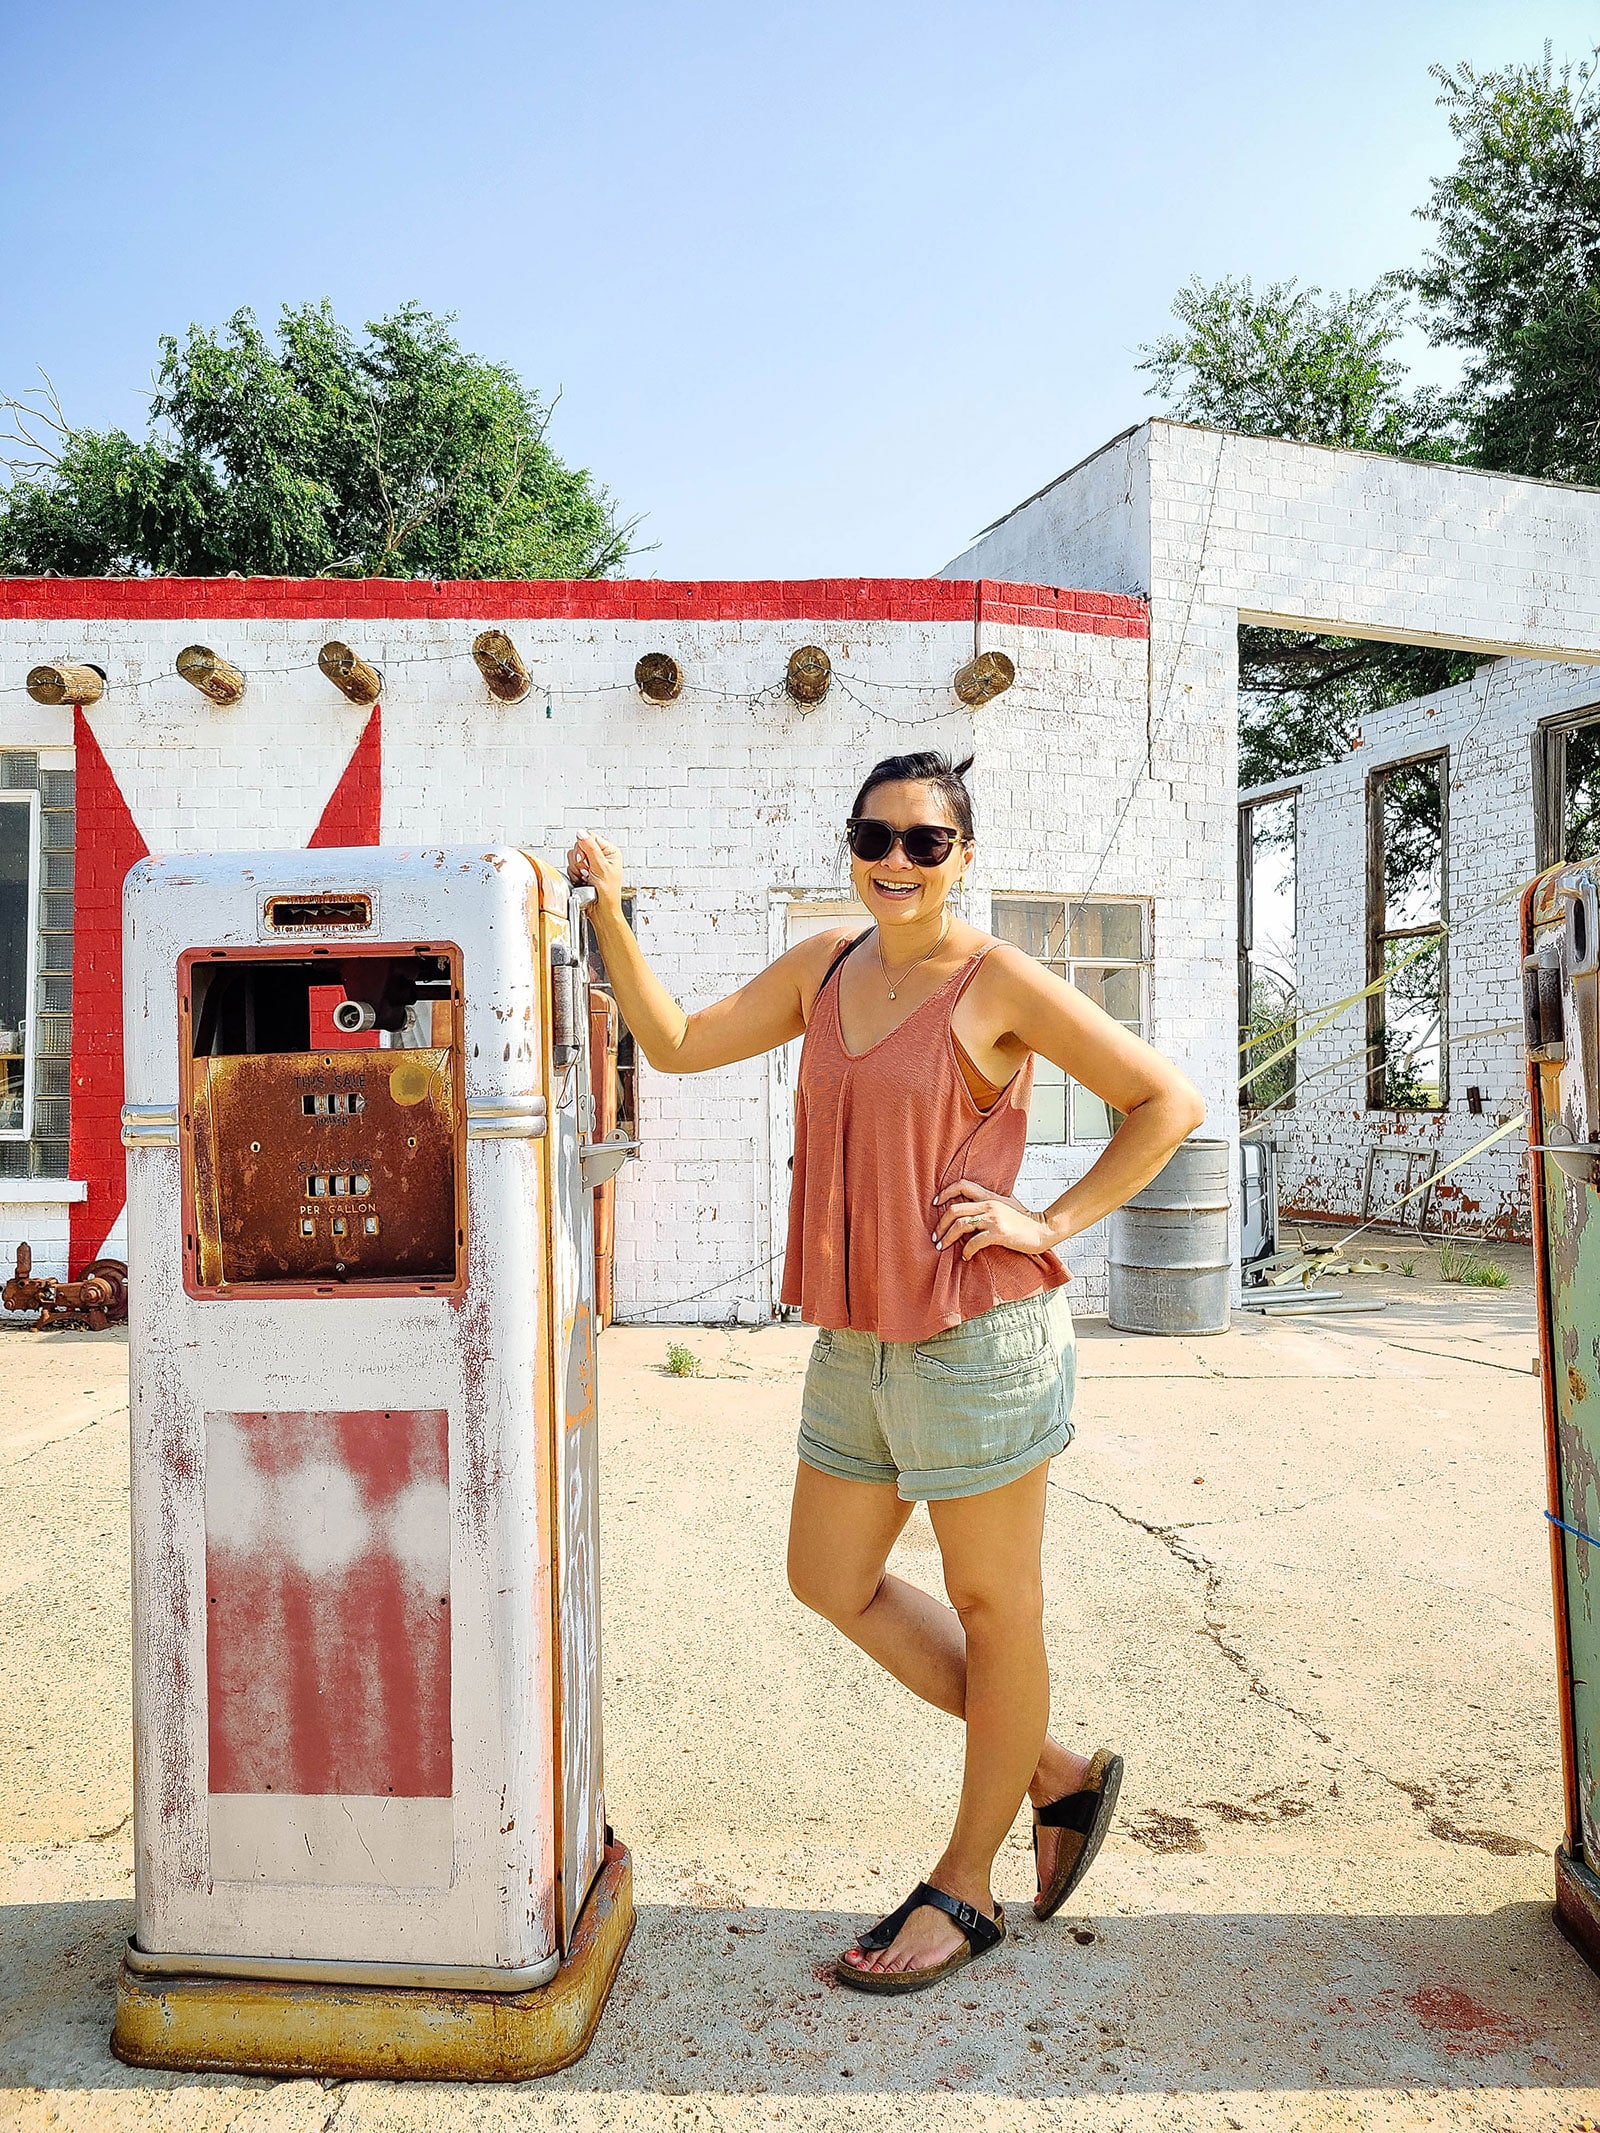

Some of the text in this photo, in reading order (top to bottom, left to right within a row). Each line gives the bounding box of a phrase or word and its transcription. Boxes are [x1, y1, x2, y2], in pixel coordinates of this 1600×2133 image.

[294, 1074, 366, 1088] THIS SALE
[298, 1158, 373, 1174] GALLONS
[300, 1202, 376, 1215] PER GALLON
